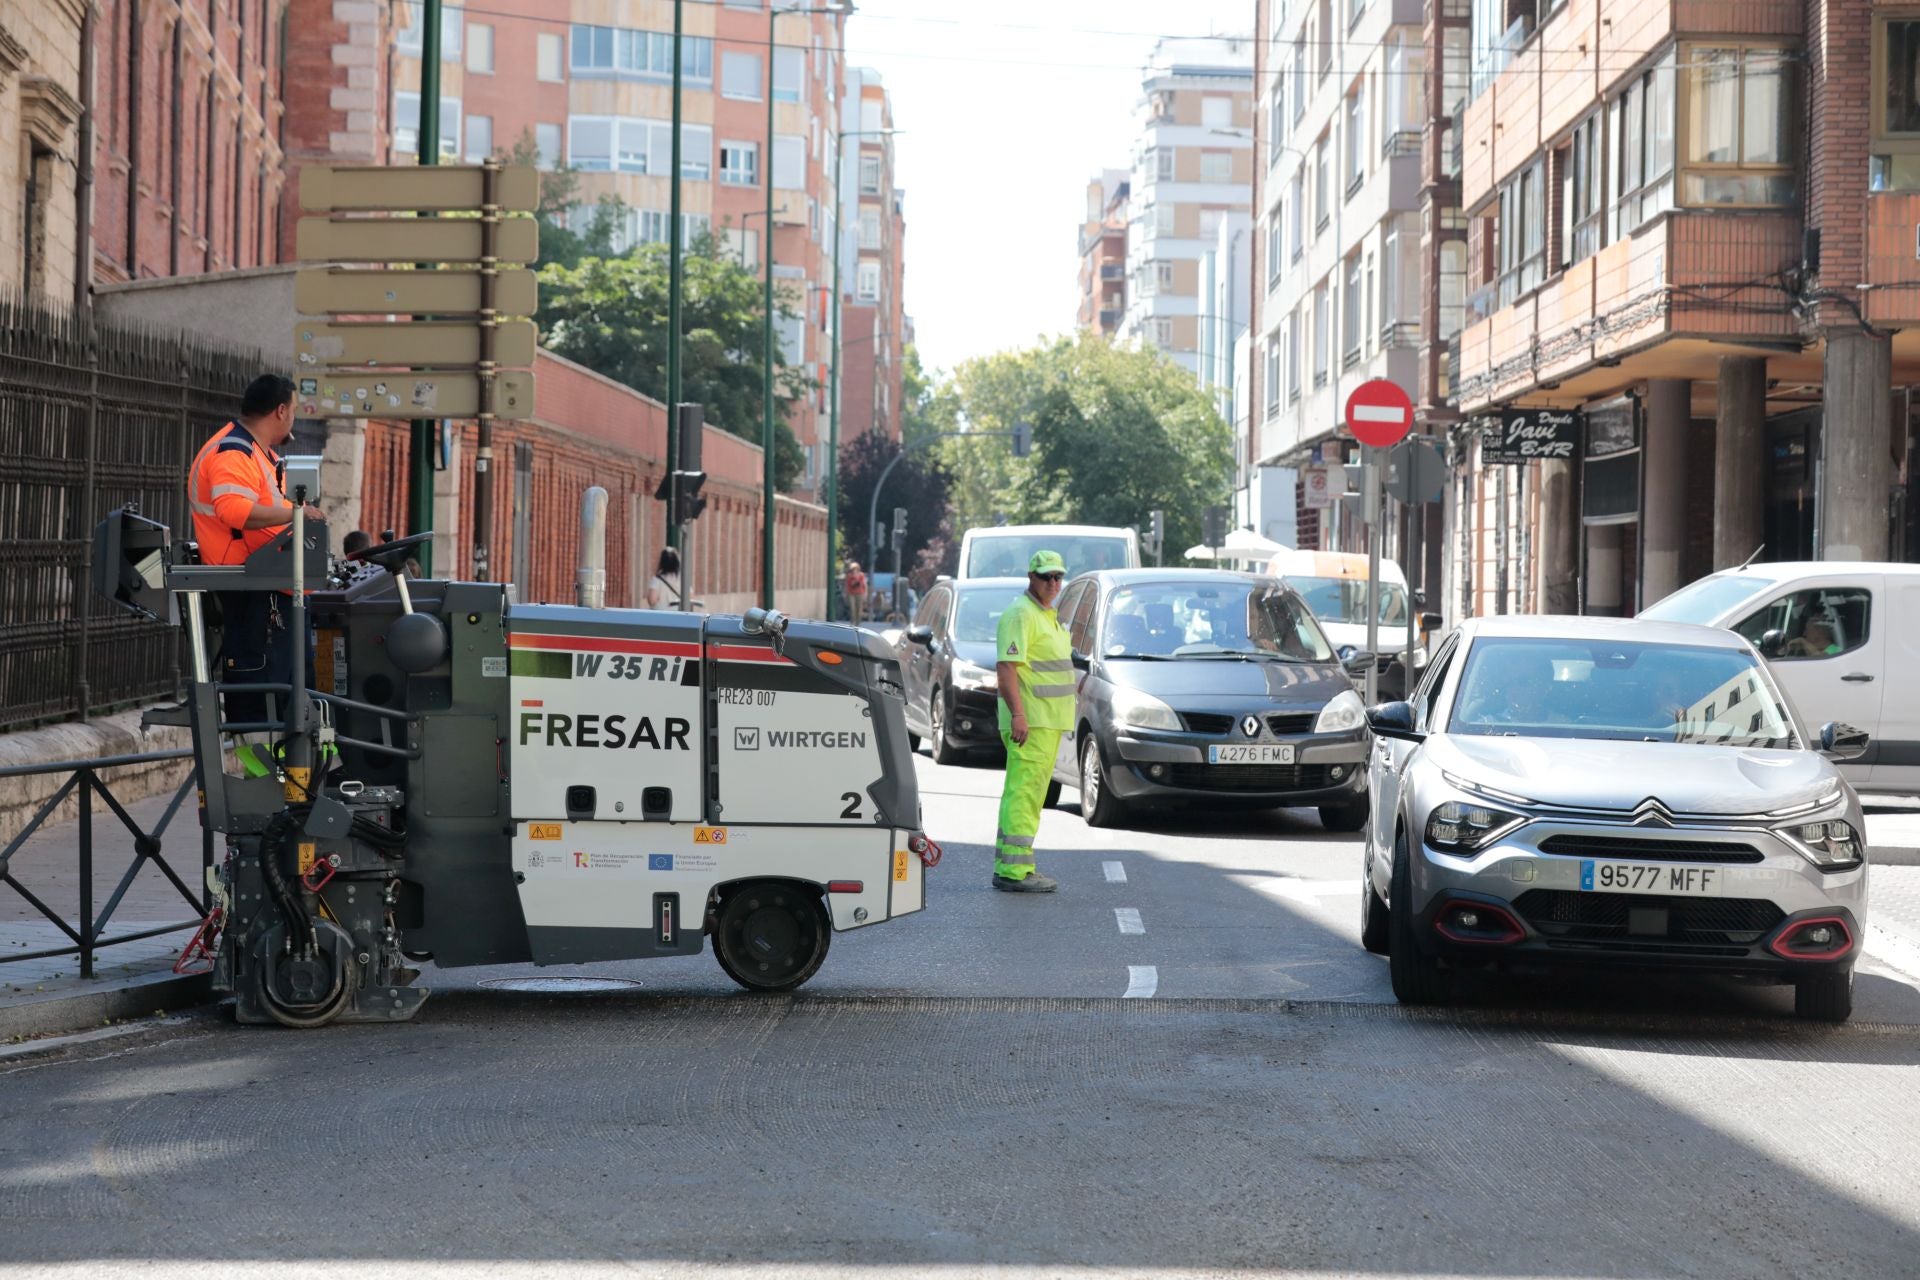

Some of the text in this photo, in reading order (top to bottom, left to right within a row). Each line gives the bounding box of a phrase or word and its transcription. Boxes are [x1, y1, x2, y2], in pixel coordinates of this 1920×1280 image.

[1539, 411, 1573, 424] Donde
[1506, 417, 1556, 444] Javi
[1520, 440, 1574, 456] BAR
[576, 653, 604, 677] W
[607, 655, 643, 680] 35
[718, 687, 777, 706] FRE23 007
[520, 712, 690, 751] FRESAR
[767, 731, 866, 748] WIRTGEN
[1219, 747, 1290, 761] 4276 FMC
[839, 791, 862, 819] 2
[1600, 865, 1661, 889] 9577
[1670, 867, 1716, 892] MFF
